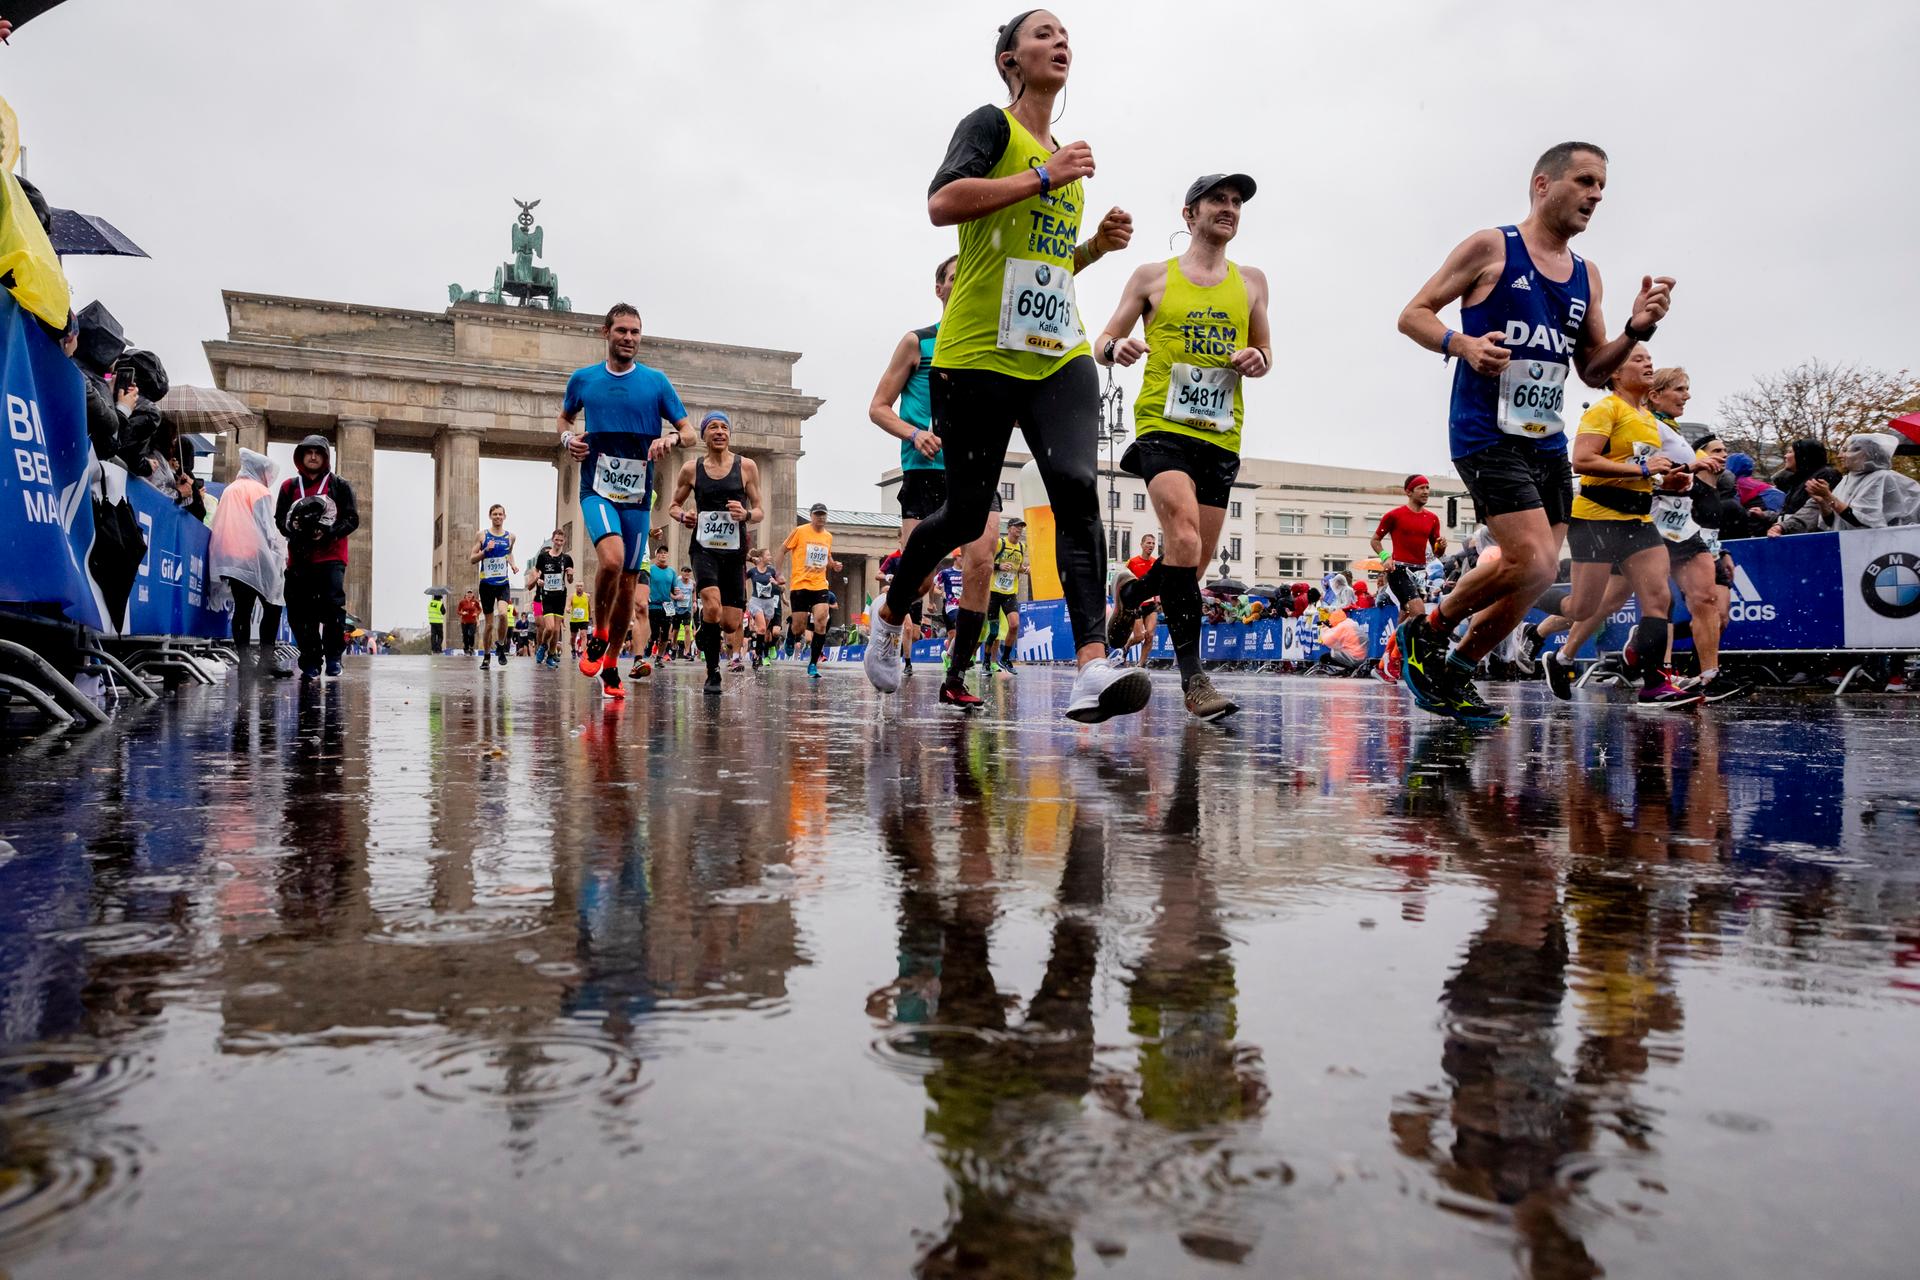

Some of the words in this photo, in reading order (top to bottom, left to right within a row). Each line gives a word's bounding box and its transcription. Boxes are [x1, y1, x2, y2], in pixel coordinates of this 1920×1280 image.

[1030, 210, 1077, 243] TEAM
[1028, 233, 1036, 252] FOR
[1036, 234, 1077, 260] KIDS
[1511, 283, 1532, 291] adidas
[1017, 289, 1071, 327] 69015
[1038, 320, 1059, 334] Katie
[1179, 325, 1237, 342] TEAM
[1028, 337, 1051, 348] Giti
[1191, 340, 1237, 355] KIDS
[1178, 384, 1226, 410] 54811
[1513, 384, 1562, 411] 66536
[1189, 406, 1216, 417] Brendan
[602, 469, 640, 488] 30467
[703, 522, 735, 535] 34479
